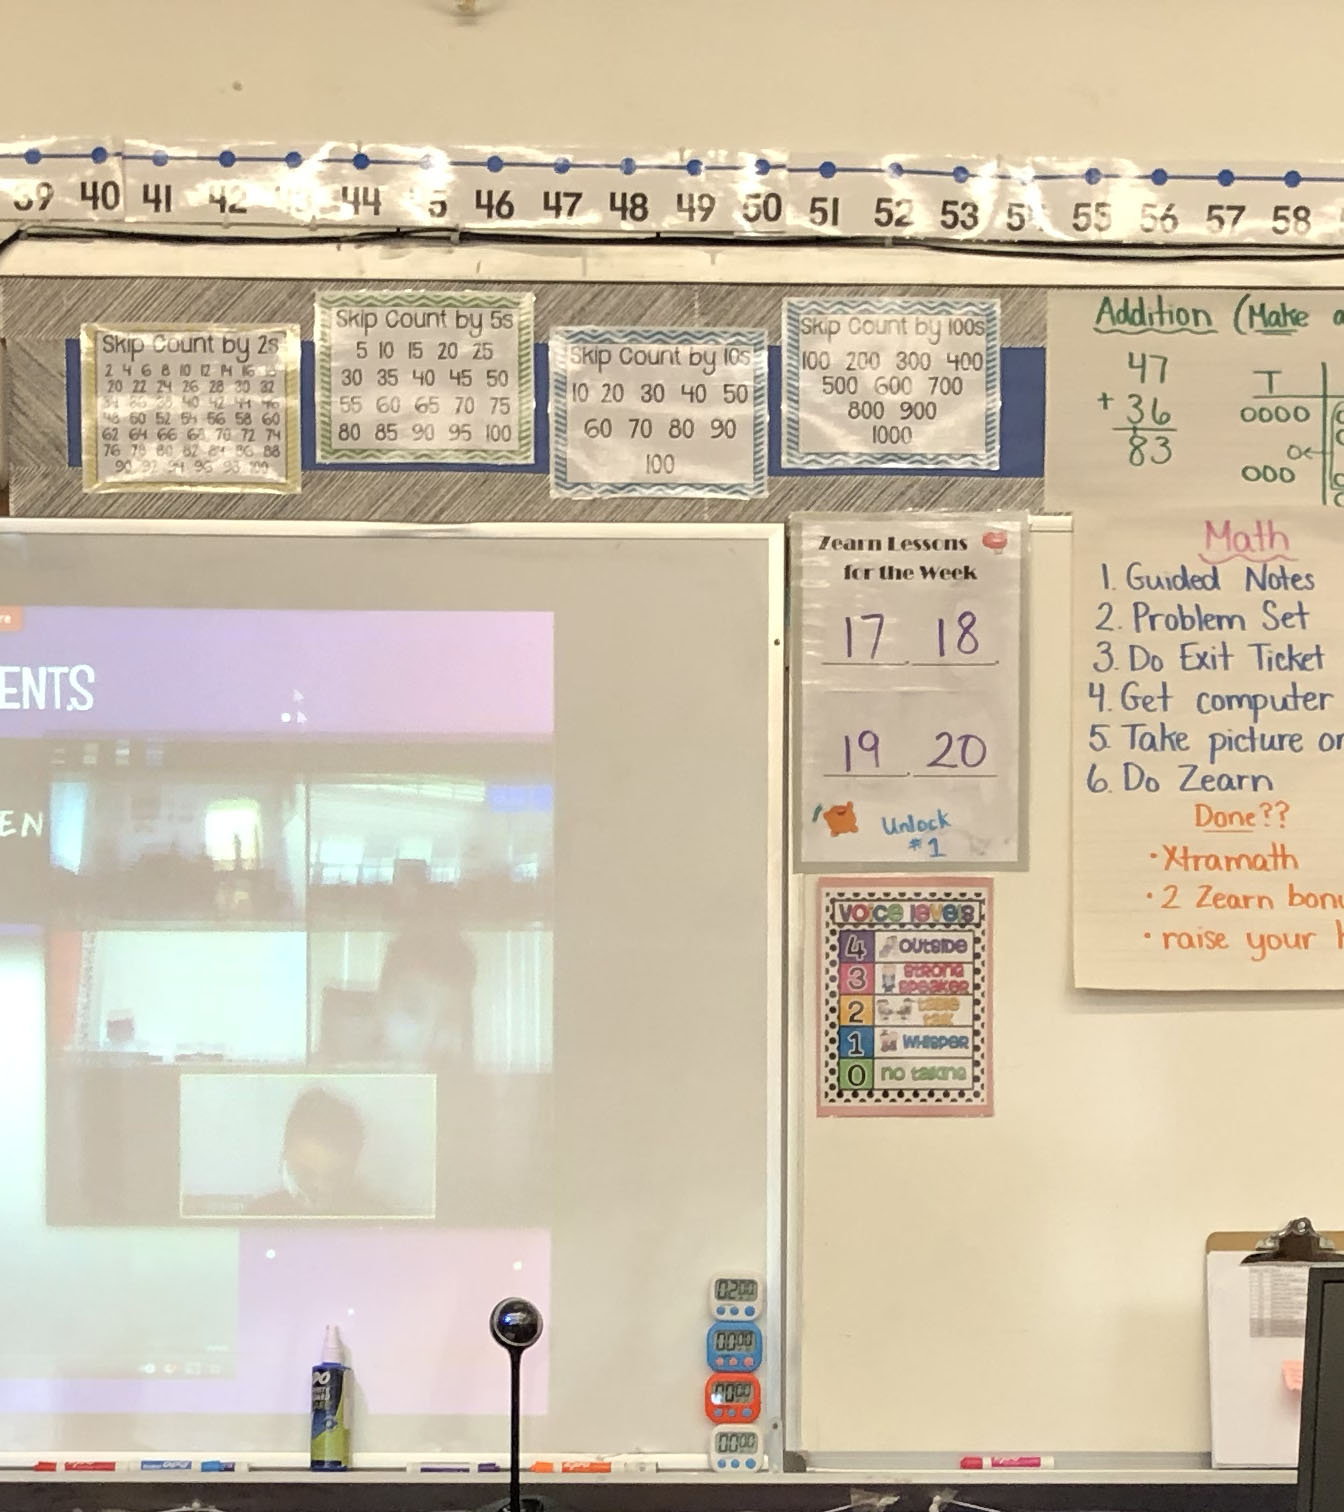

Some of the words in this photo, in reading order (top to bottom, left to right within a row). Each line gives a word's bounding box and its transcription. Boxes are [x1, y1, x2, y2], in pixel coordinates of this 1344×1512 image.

[476, 190, 514, 219] 46
[610, 193, 648, 221] 48
[336, 310, 379, 334] Skip
[386, 310, 446, 329] Count
[456, 310, 483, 338] by
[490, 311, 513, 329] 5s
[1095, 295, 1213, 328] Addition
[1233, 294, 1309, 335] (Make
[801, 318, 840, 342] Skip
[849, 318, 907, 335] Count
[916, 317, 941, 344] by
[948, 318, 985, 335] 100s
[570, 346, 611, 375] Skip
[620, 346, 681, 366] Count
[689, 346, 716, 375] by
[724, 348, 750, 367] 10s
[1128, 351, 1169, 384] 47
[449, 369, 472, 386] 45
[1252, 370, 1283, 394] T
[681, 384, 706, 402] 40
[723, 384, 748, 403] 50
[900, 401, 936, 419] 900
[1127, 394, 1171, 425] 36
[338, 424, 361, 441] 80
[629, 420, 653, 438] 70
[872, 426, 912, 444] 1000
[1129, 435, 1172, 466] 83
[818, 536, 882, 551] Zearn
[887, 535, 968, 551] Lessons
[1203, 520, 1290, 554] Math
[844, 565, 875, 580] for
[879, 565, 914, 580] the
[919, 564, 978, 580] Week
[1102, 563, 1116, 591] 1.
[1126, 563, 1221, 591] Guided
[1245, 565, 1316, 591] Notes
[1095, 603, 1122, 632] 2.
[1133, 602, 1246, 633] Problem
[1262, 600, 1310, 631] Set
[845, 613, 885, 659] 17
[937, 610, 979, 657] 18
[1093, 642, 1119, 671] 3.
[1129, 645, 1164, 672] Do
[1181, 642, 1234, 671] Exit
[1248, 641, 1325, 671] Ticket
[1089, 682, 1112, 713] 4.
[1121, 681, 1173, 713] Get
[1197, 681, 1334, 723] computer
[844, 730, 880, 772] 19
[927, 731, 987, 768] 20
[1122, 723, 1190, 751] Take
[1209, 722, 1303, 763] picture
[1086, 763, 1113, 794] 6.
[1124, 763, 1160, 793] Do
[1178, 763, 1273, 792] Zearn
[882, 809, 951, 836] Unlock
[1194, 801, 1291, 830] Done??
[1163, 843, 1299, 872] Xtramath
[1160, 885, 1181, 909] 2
[1196, 885, 1273, 910] Zearn
[847, 935, 866, 960] 4
[1163, 926, 1229, 951] raise
[1246, 930, 1316, 961] your
[847, 966, 866, 990] 3
[847, 1000, 864, 1024] 2
[847, 1033, 864, 1056] 1
[847, 1064, 866, 1086] 0
